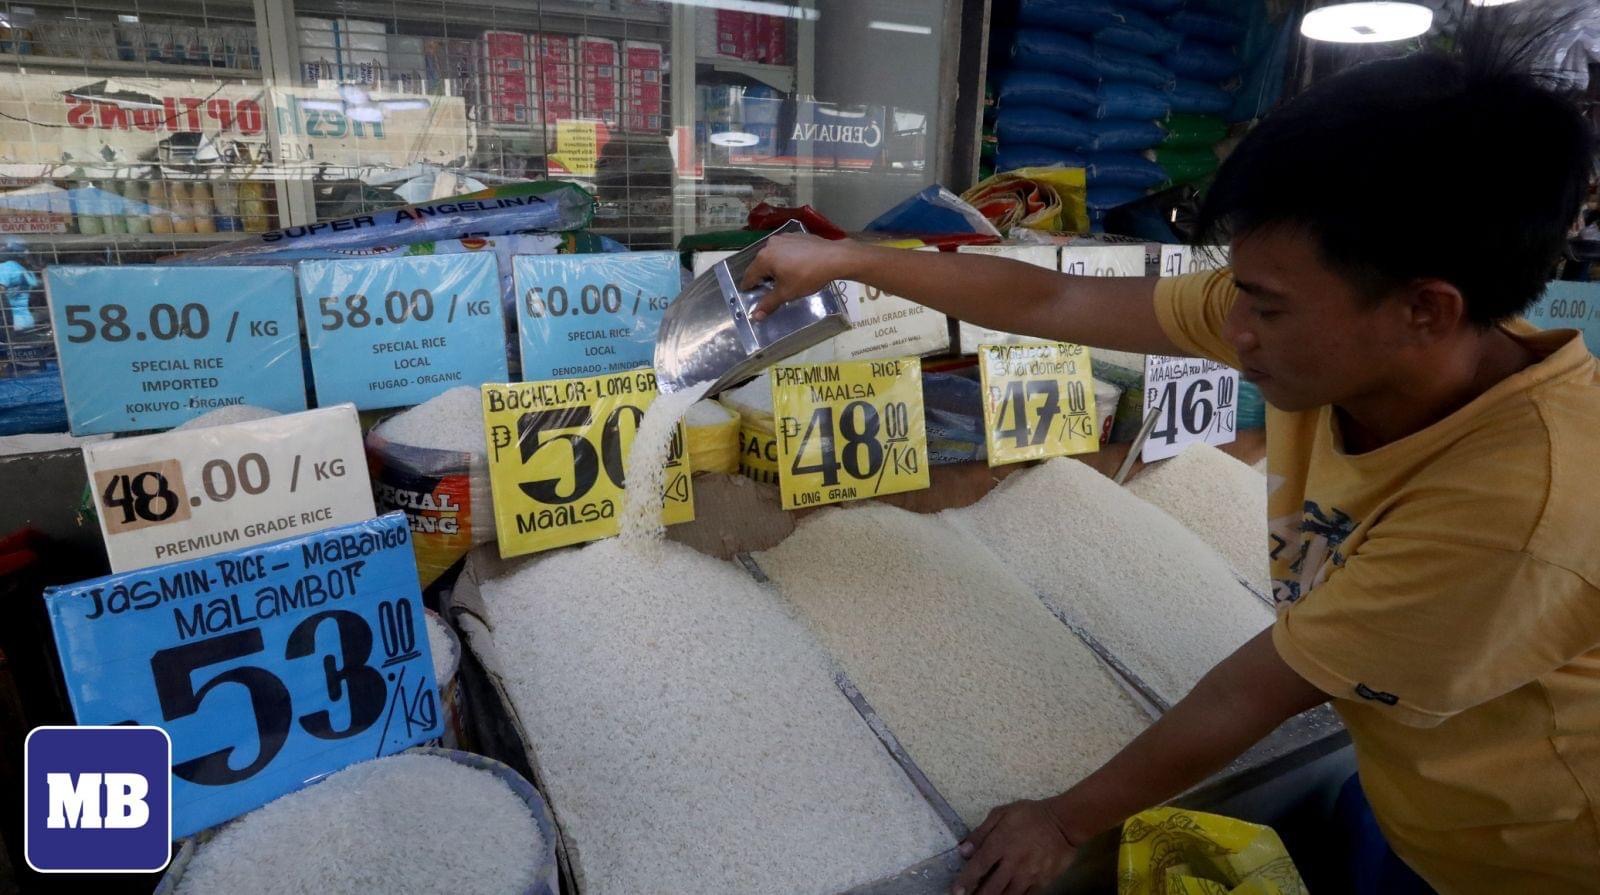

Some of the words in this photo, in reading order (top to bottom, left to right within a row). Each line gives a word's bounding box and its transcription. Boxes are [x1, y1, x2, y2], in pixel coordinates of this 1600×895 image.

[261, 215, 376, 243] SUPER
[394, 194, 547, 224] ANGELINA
[318, 288, 434, 332] 58.00
[466, 300, 491, 317] KG
[525, 283, 622, 319] 60.00
[648, 296, 669, 311] KG
[1550, 299, 1586, 319] 60.00
[65, 302, 210, 344] 58.00
[250, 320, 279, 337] KG
[882, 310, 908, 323] GRADE
[908, 306, 924, 316] RICE
[567, 329, 609, 342] SPECIAL
[610, 327, 631, 339] RICE
[874, 326, 898, 338] LOCAL
[372, 337, 420, 354] SPECIAL
[421, 335, 447, 350] RICE
[584, 345, 617, 357] LOCAL
[131, 358, 191, 373] SPECIAL
[194, 357, 224, 371] RICE
[394, 357, 431, 370] LOCAL
[552, 364, 601, 377] DENORADO
[774, 365, 840, 387] PREMIUM
[871, 359, 903, 378] RICE
[1150, 362, 1189, 383] MAALSA
[142, 377, 219, 393] IMPORTED
[368, 378, 408, 391] IFUGAO
[416, 371, 463, 386] ORGANIC
[811, 383, 876, 404] MAALSA
[126, 400, 181, 415] KOKUYO
[994, 379, 1061, 449] 47
[1067, 380, 1085, 412] 00
[1150, 378, 1214, 445] 46
[1217, 375, 1234, 405] 00
[517, 404, 645, 505] 50
[791, 400, 884, 488] 48
[884, 401, 909, 438] 00
[313, 458, 347, 482] KG
[793, 490, 821, 507] LONG
[828, 487, 858, 500] GRAIN
[154, 527, 240, 560] PREMIUM
[243, 514, 296, 539] GRADE
[301, 506, 333, 527] RICE
[150, 609, 388, 787] 53
[377, 597, 416, 659] 00
